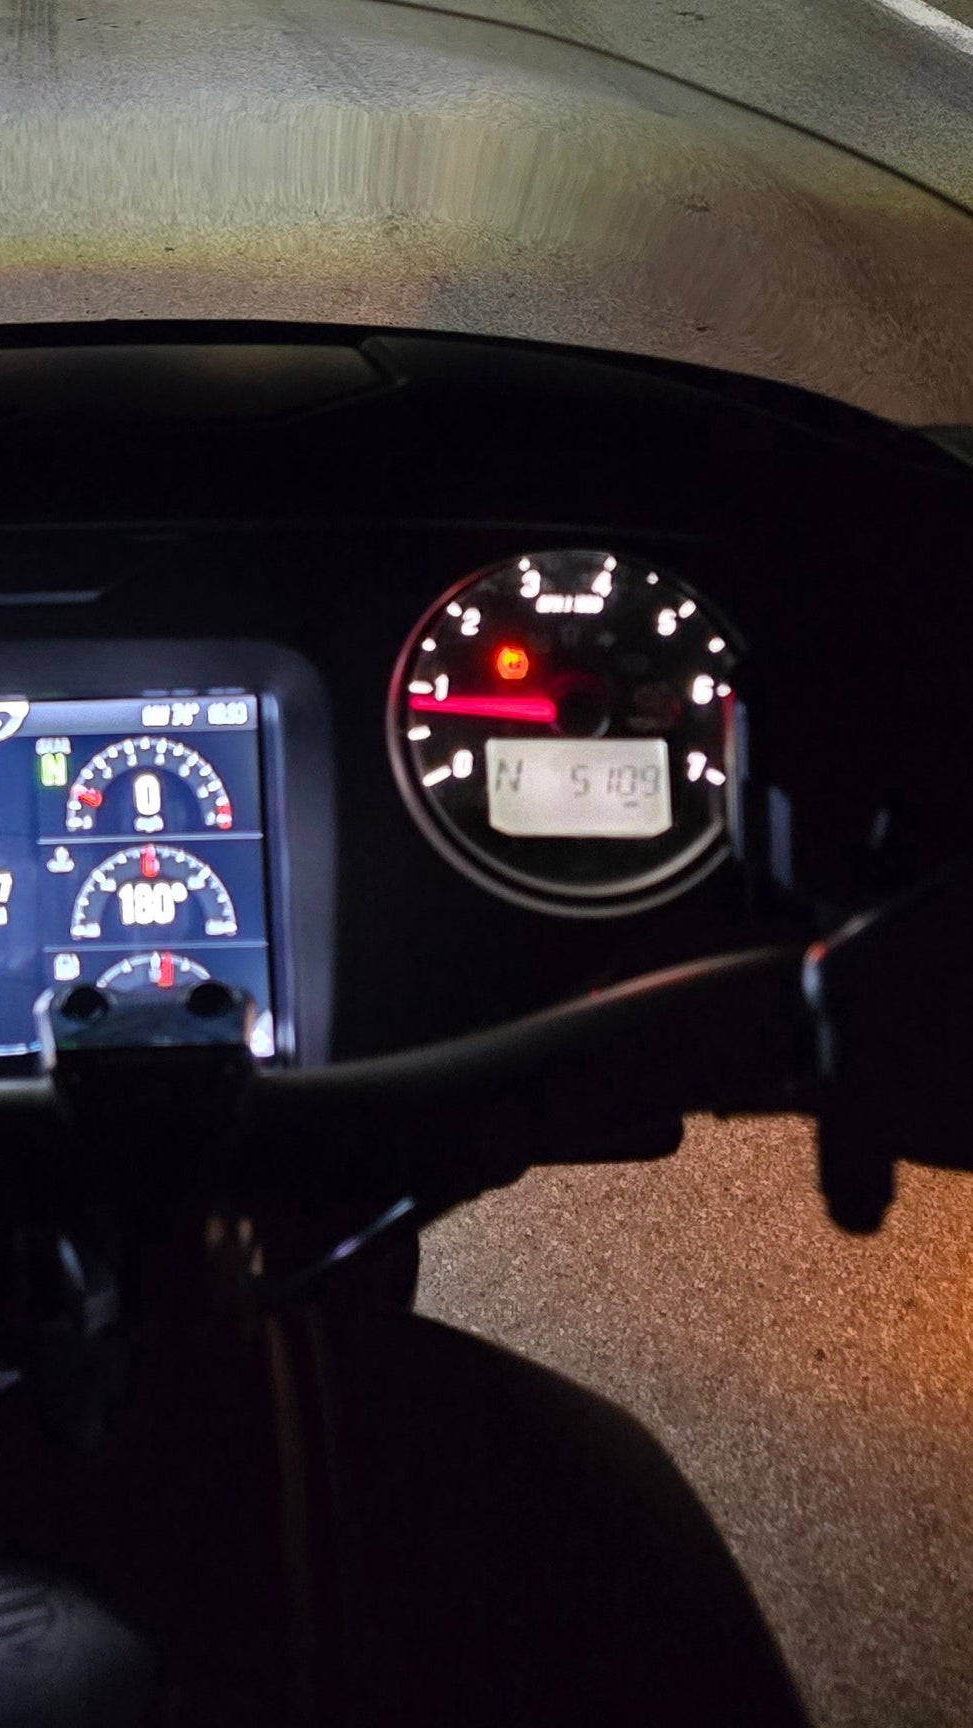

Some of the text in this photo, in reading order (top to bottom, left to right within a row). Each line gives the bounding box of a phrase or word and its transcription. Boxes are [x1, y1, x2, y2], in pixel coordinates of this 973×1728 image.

[519, 569, 541, 599] 3
[591, 570, 612, 598] 4
[460, 607, 482, 636] 2
[657, 608, 677, 637] 5
[434, 673, 450, 702] 1
[692, 674, 715, 705] 6
[40, 751, 69, 788] N
[452, 749, 474, 779] 0
[495, 758, 524, 793] N
[687, 751, 708, 782] 7
[134, 774, 161, 815] 0
